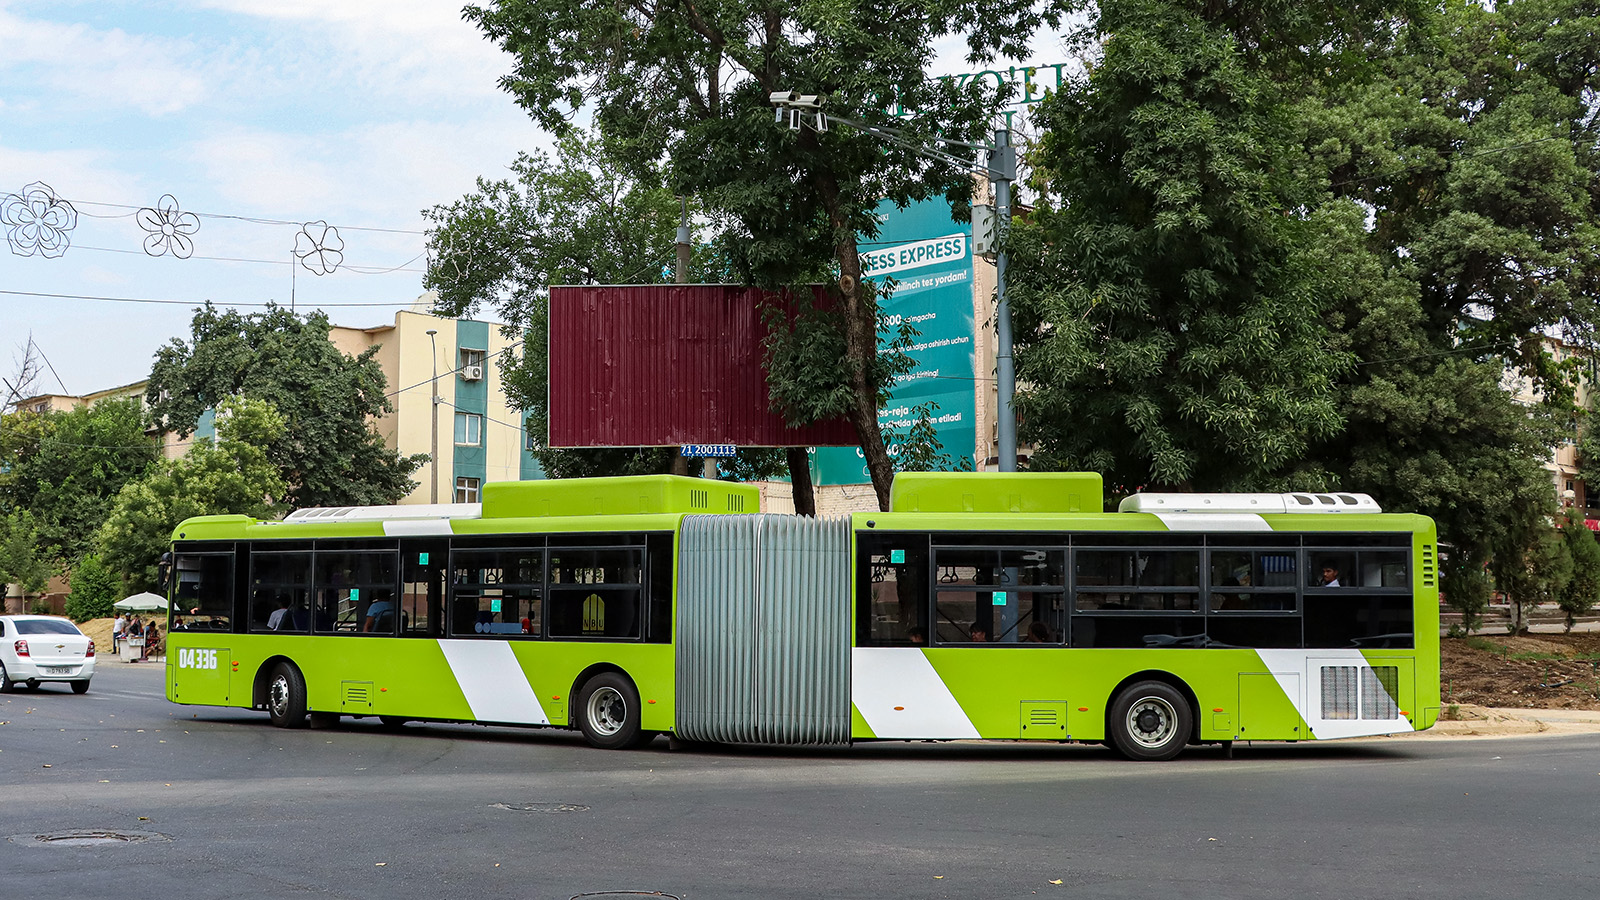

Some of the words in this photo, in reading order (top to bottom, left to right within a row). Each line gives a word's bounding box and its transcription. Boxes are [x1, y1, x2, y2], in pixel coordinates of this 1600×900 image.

[900, 239, 962, 265] EXPRESS
[922, 279, 934, 287] tez
[935, 269, 967, 286] yordam!
[878, 405, 909, 417] es-reja
[938, 412, 962, 423] etiladi
[681, 445, 692, 454] 71
[695, 445, 736, 455] 2001113
[179, 648, 217, 669] 04336
